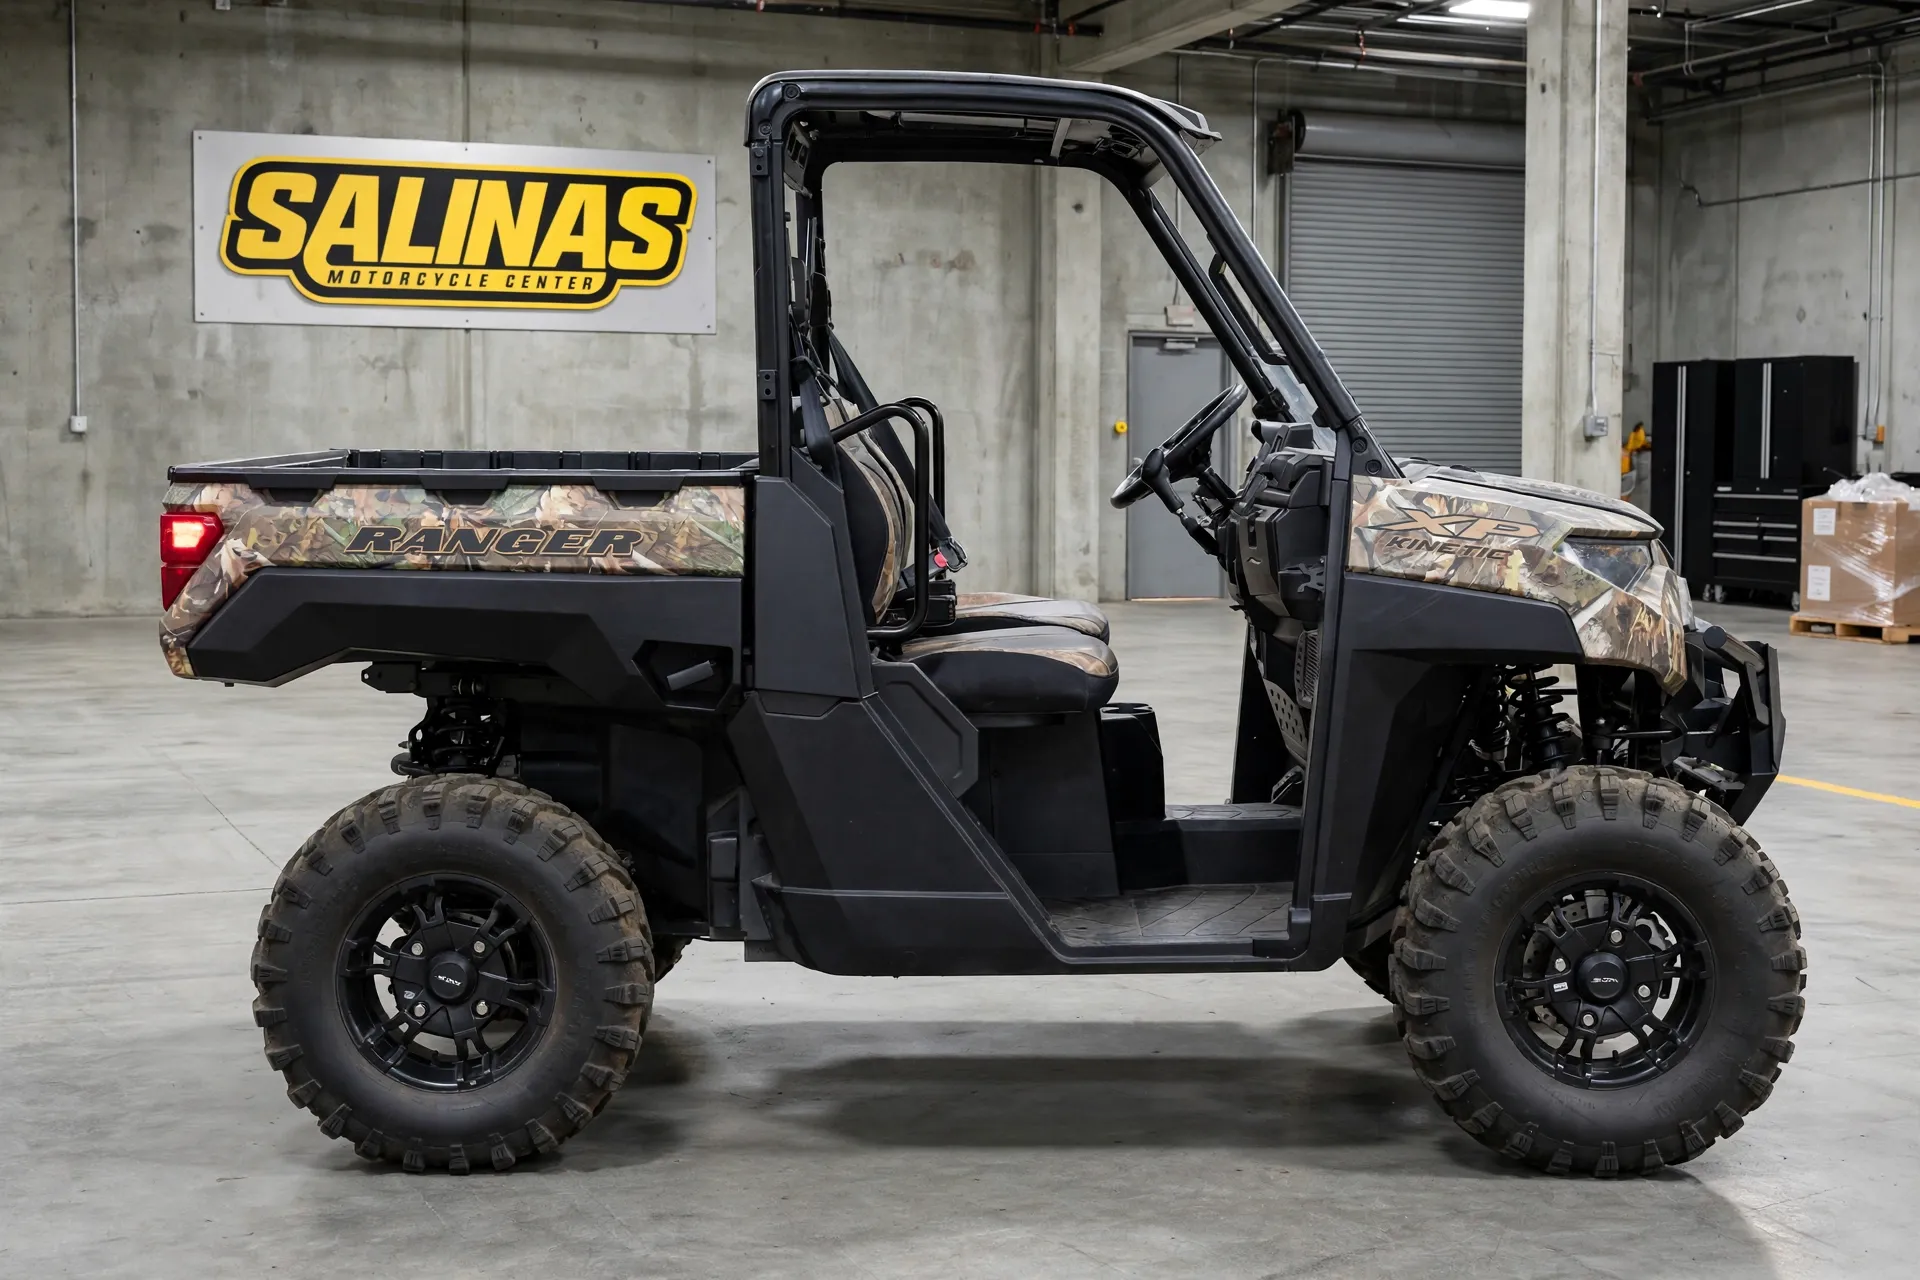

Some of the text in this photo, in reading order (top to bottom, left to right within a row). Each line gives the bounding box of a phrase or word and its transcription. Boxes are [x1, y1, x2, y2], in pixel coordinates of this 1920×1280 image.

[236, 171, 683, 271] SALINAS
[327, 269, 593, 290] MOTORCYCLE CENTER
[1367, 507, 1543, 541] XP
[344, 525, 644, 556] RANGER
[1386, 536, 1512, 560] KINETIC
